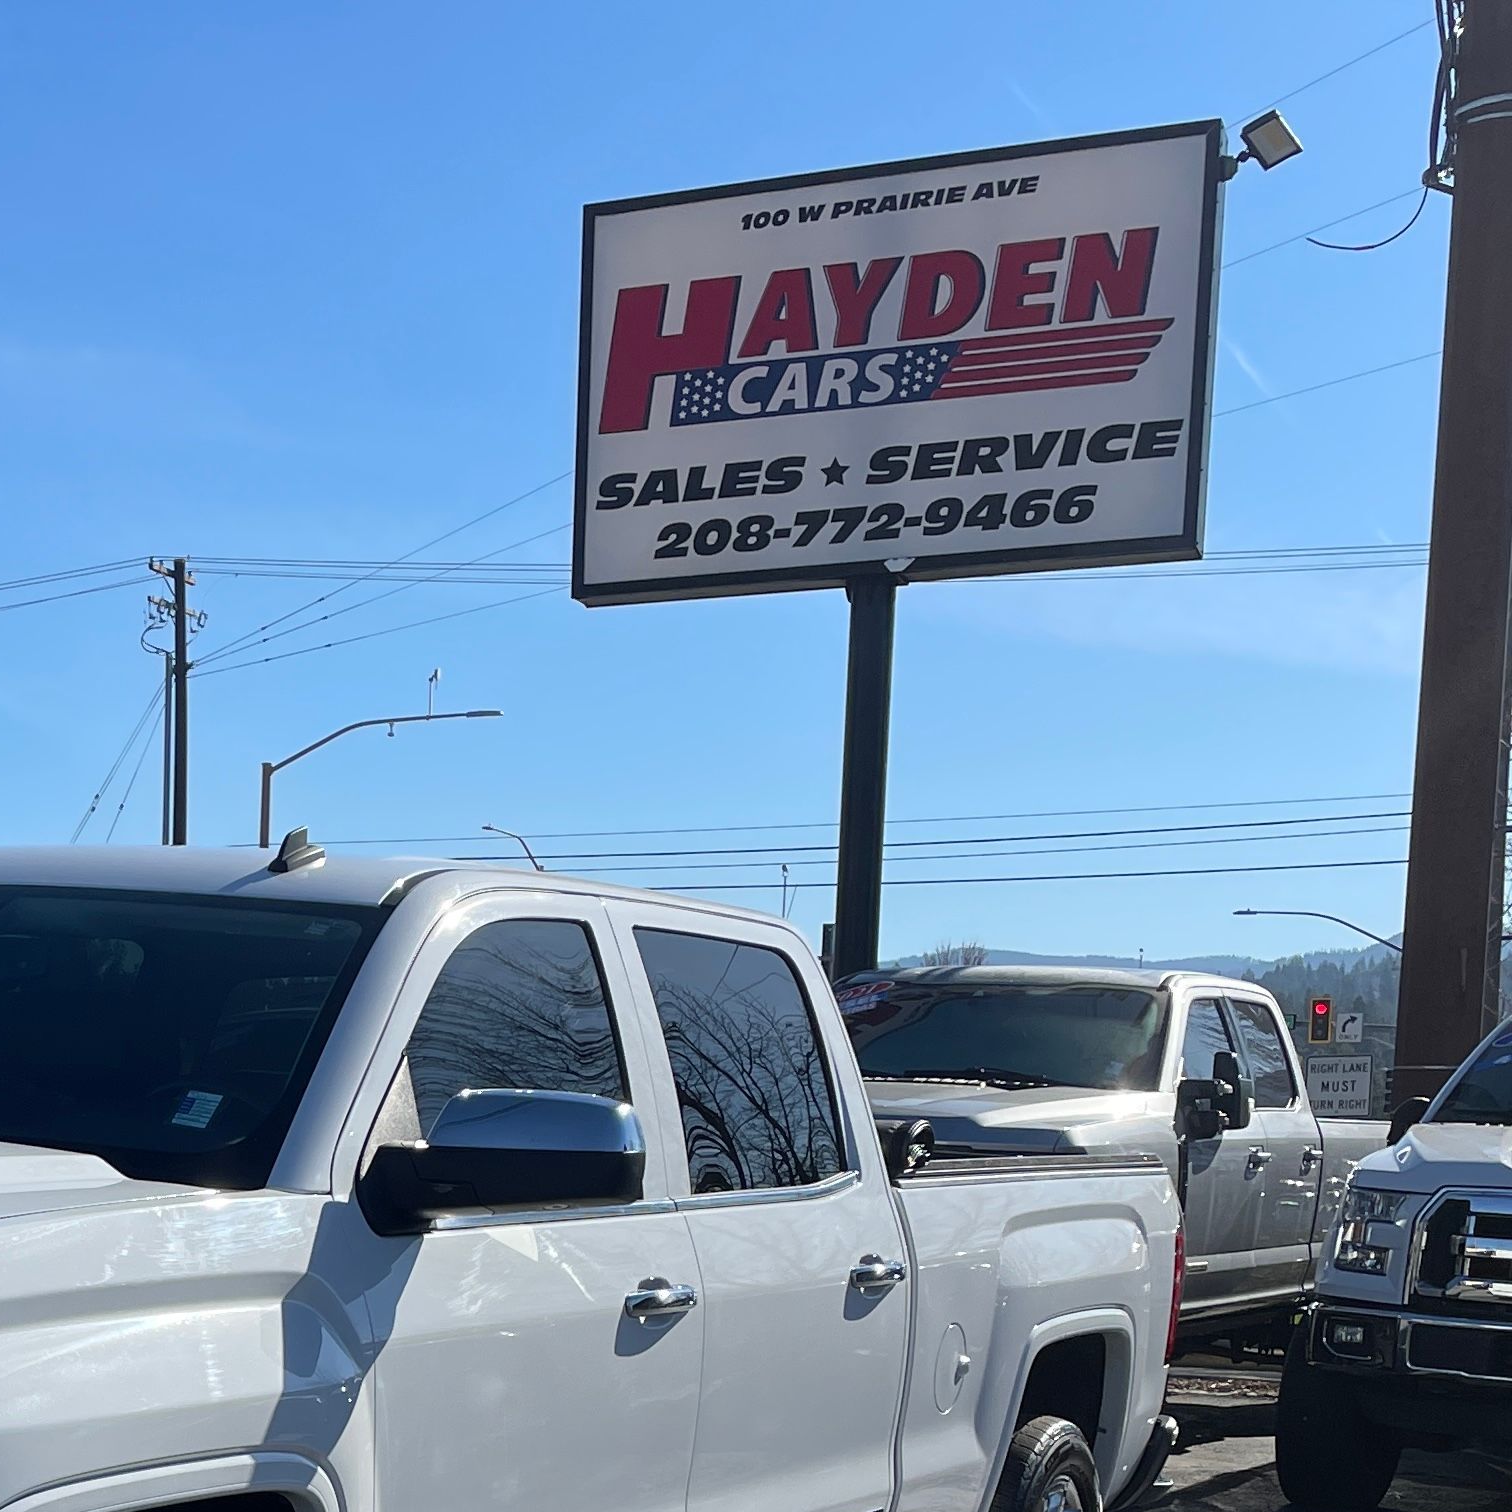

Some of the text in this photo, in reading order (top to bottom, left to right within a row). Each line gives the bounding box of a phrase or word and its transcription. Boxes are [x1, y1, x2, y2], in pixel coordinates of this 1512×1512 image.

[741, 175, 1040, 231] 100 W PRAIRIE AVE
[598, 226, 1159, 435] HAYDEN
[726, 351, 899, 416] CARS
[595, 418, 1184, 511] SALES SERVICE
[653, 485, 1099, 560] 208-772-9466
[1310, 1062, 1368, 1074] RIGHT LANE
[1320, 1080, 1357, 1093] MUST
[1312, 1099, 1367, 1111] URN RIGHT
